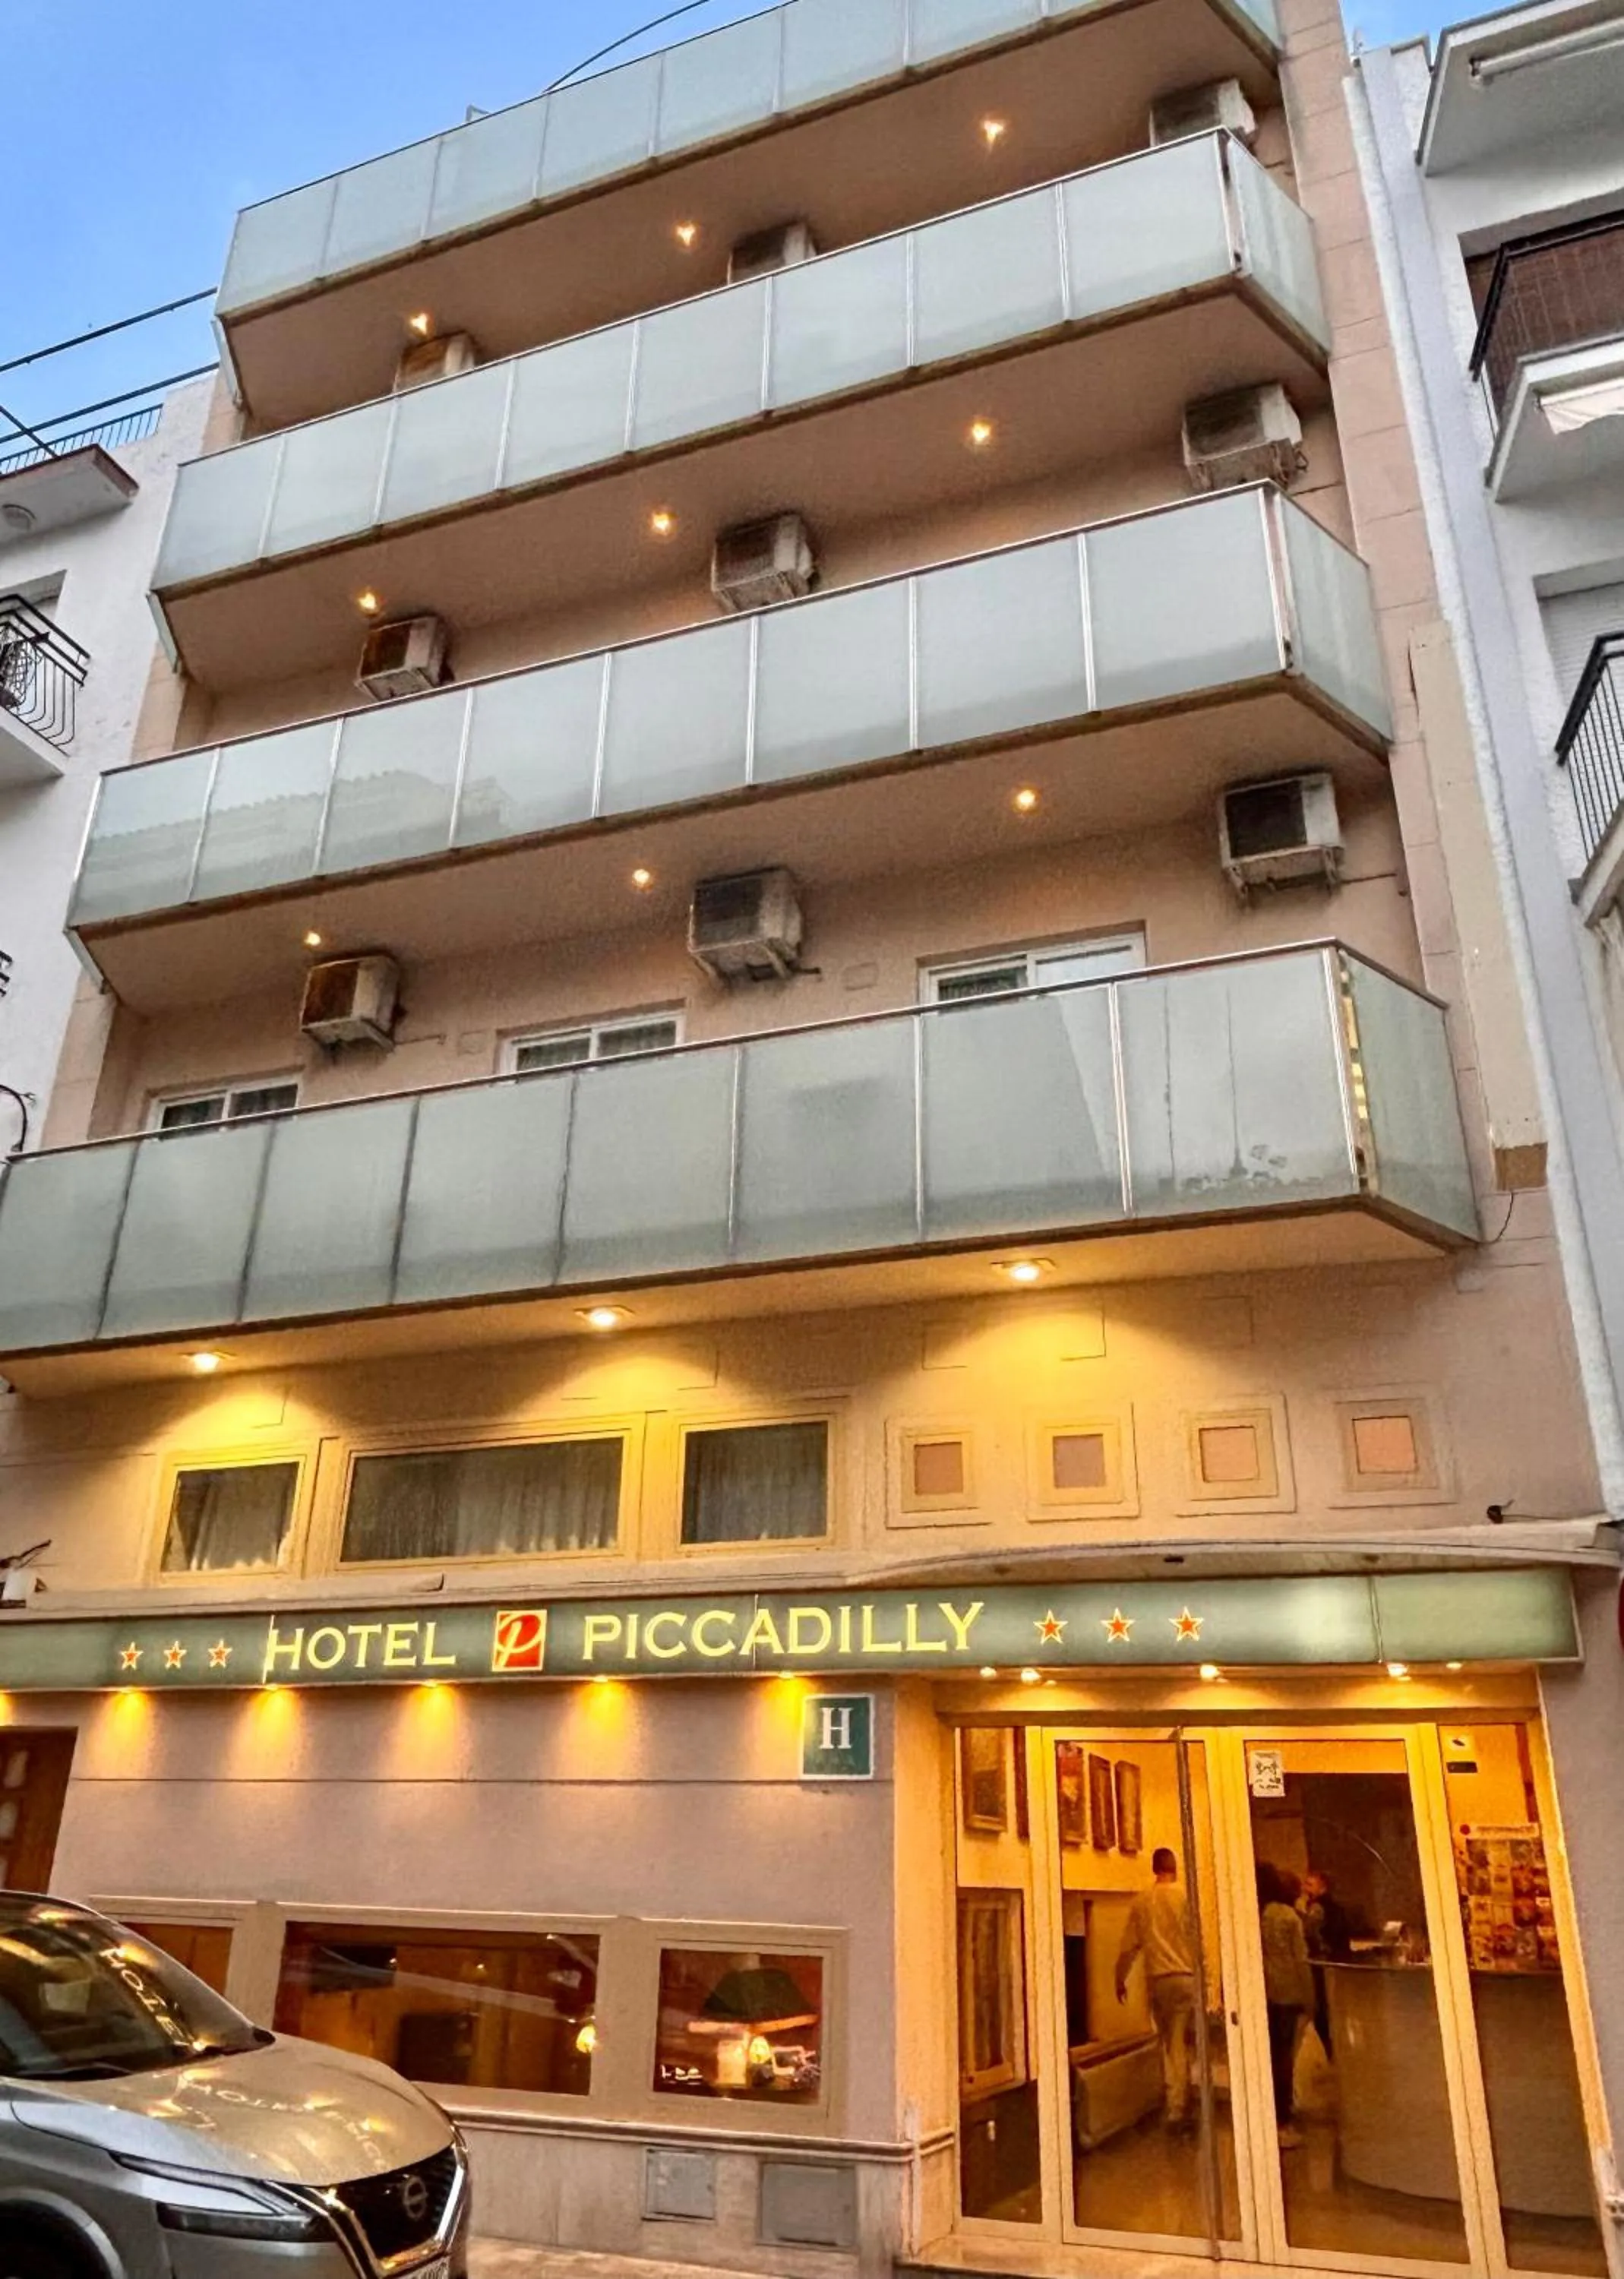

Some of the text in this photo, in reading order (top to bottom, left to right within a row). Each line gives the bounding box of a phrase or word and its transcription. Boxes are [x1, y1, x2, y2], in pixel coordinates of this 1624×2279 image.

[266, 1621, 456, 1671] HOTEL
[582, 1602, 984, 1661] PICCADILLY
[820, 1707, 852, 1750] H
